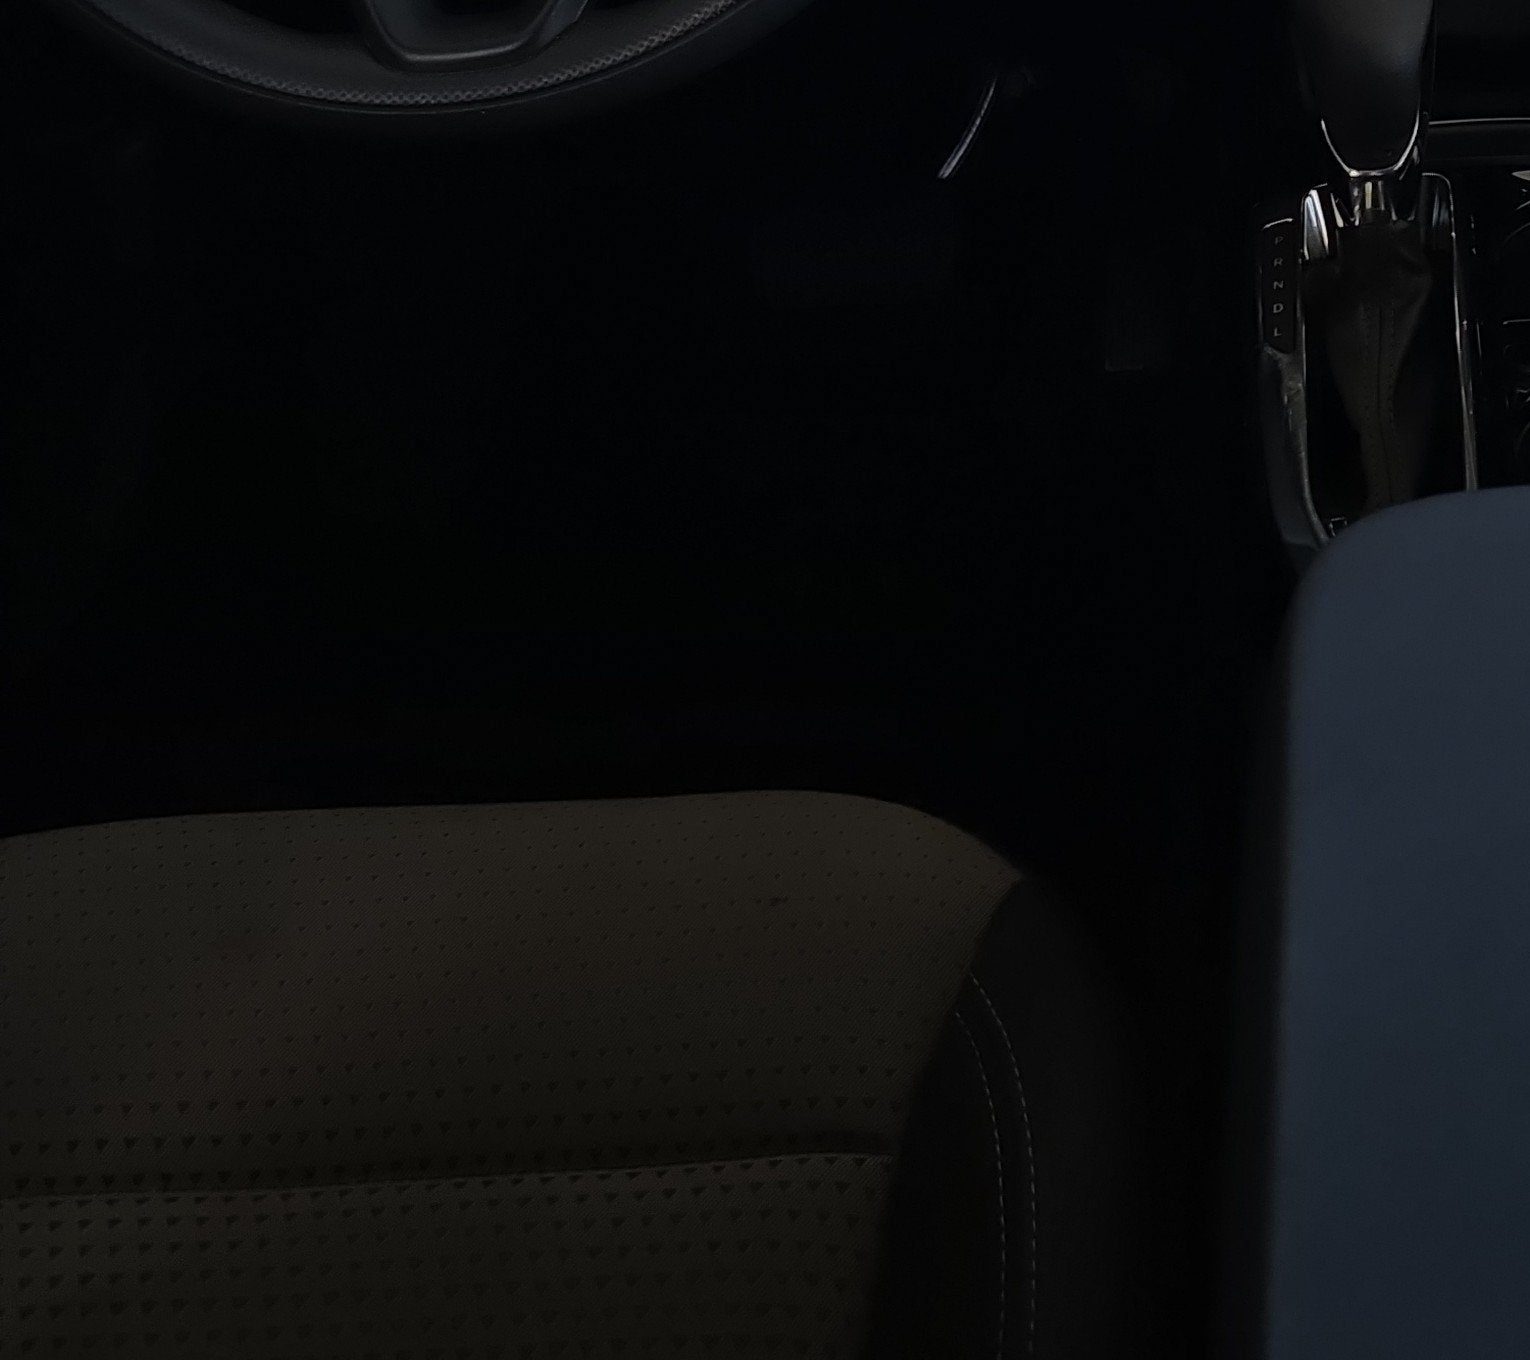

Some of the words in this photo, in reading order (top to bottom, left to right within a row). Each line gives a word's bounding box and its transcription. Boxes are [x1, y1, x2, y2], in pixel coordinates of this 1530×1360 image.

[1274, 235, 1284, 246] P
[1273, 257, 1284, 268] R
[1273, 280, 1284, 290] N
[1272, 302, 1284, 314] D
[1273, 327, 1283, 337] L
